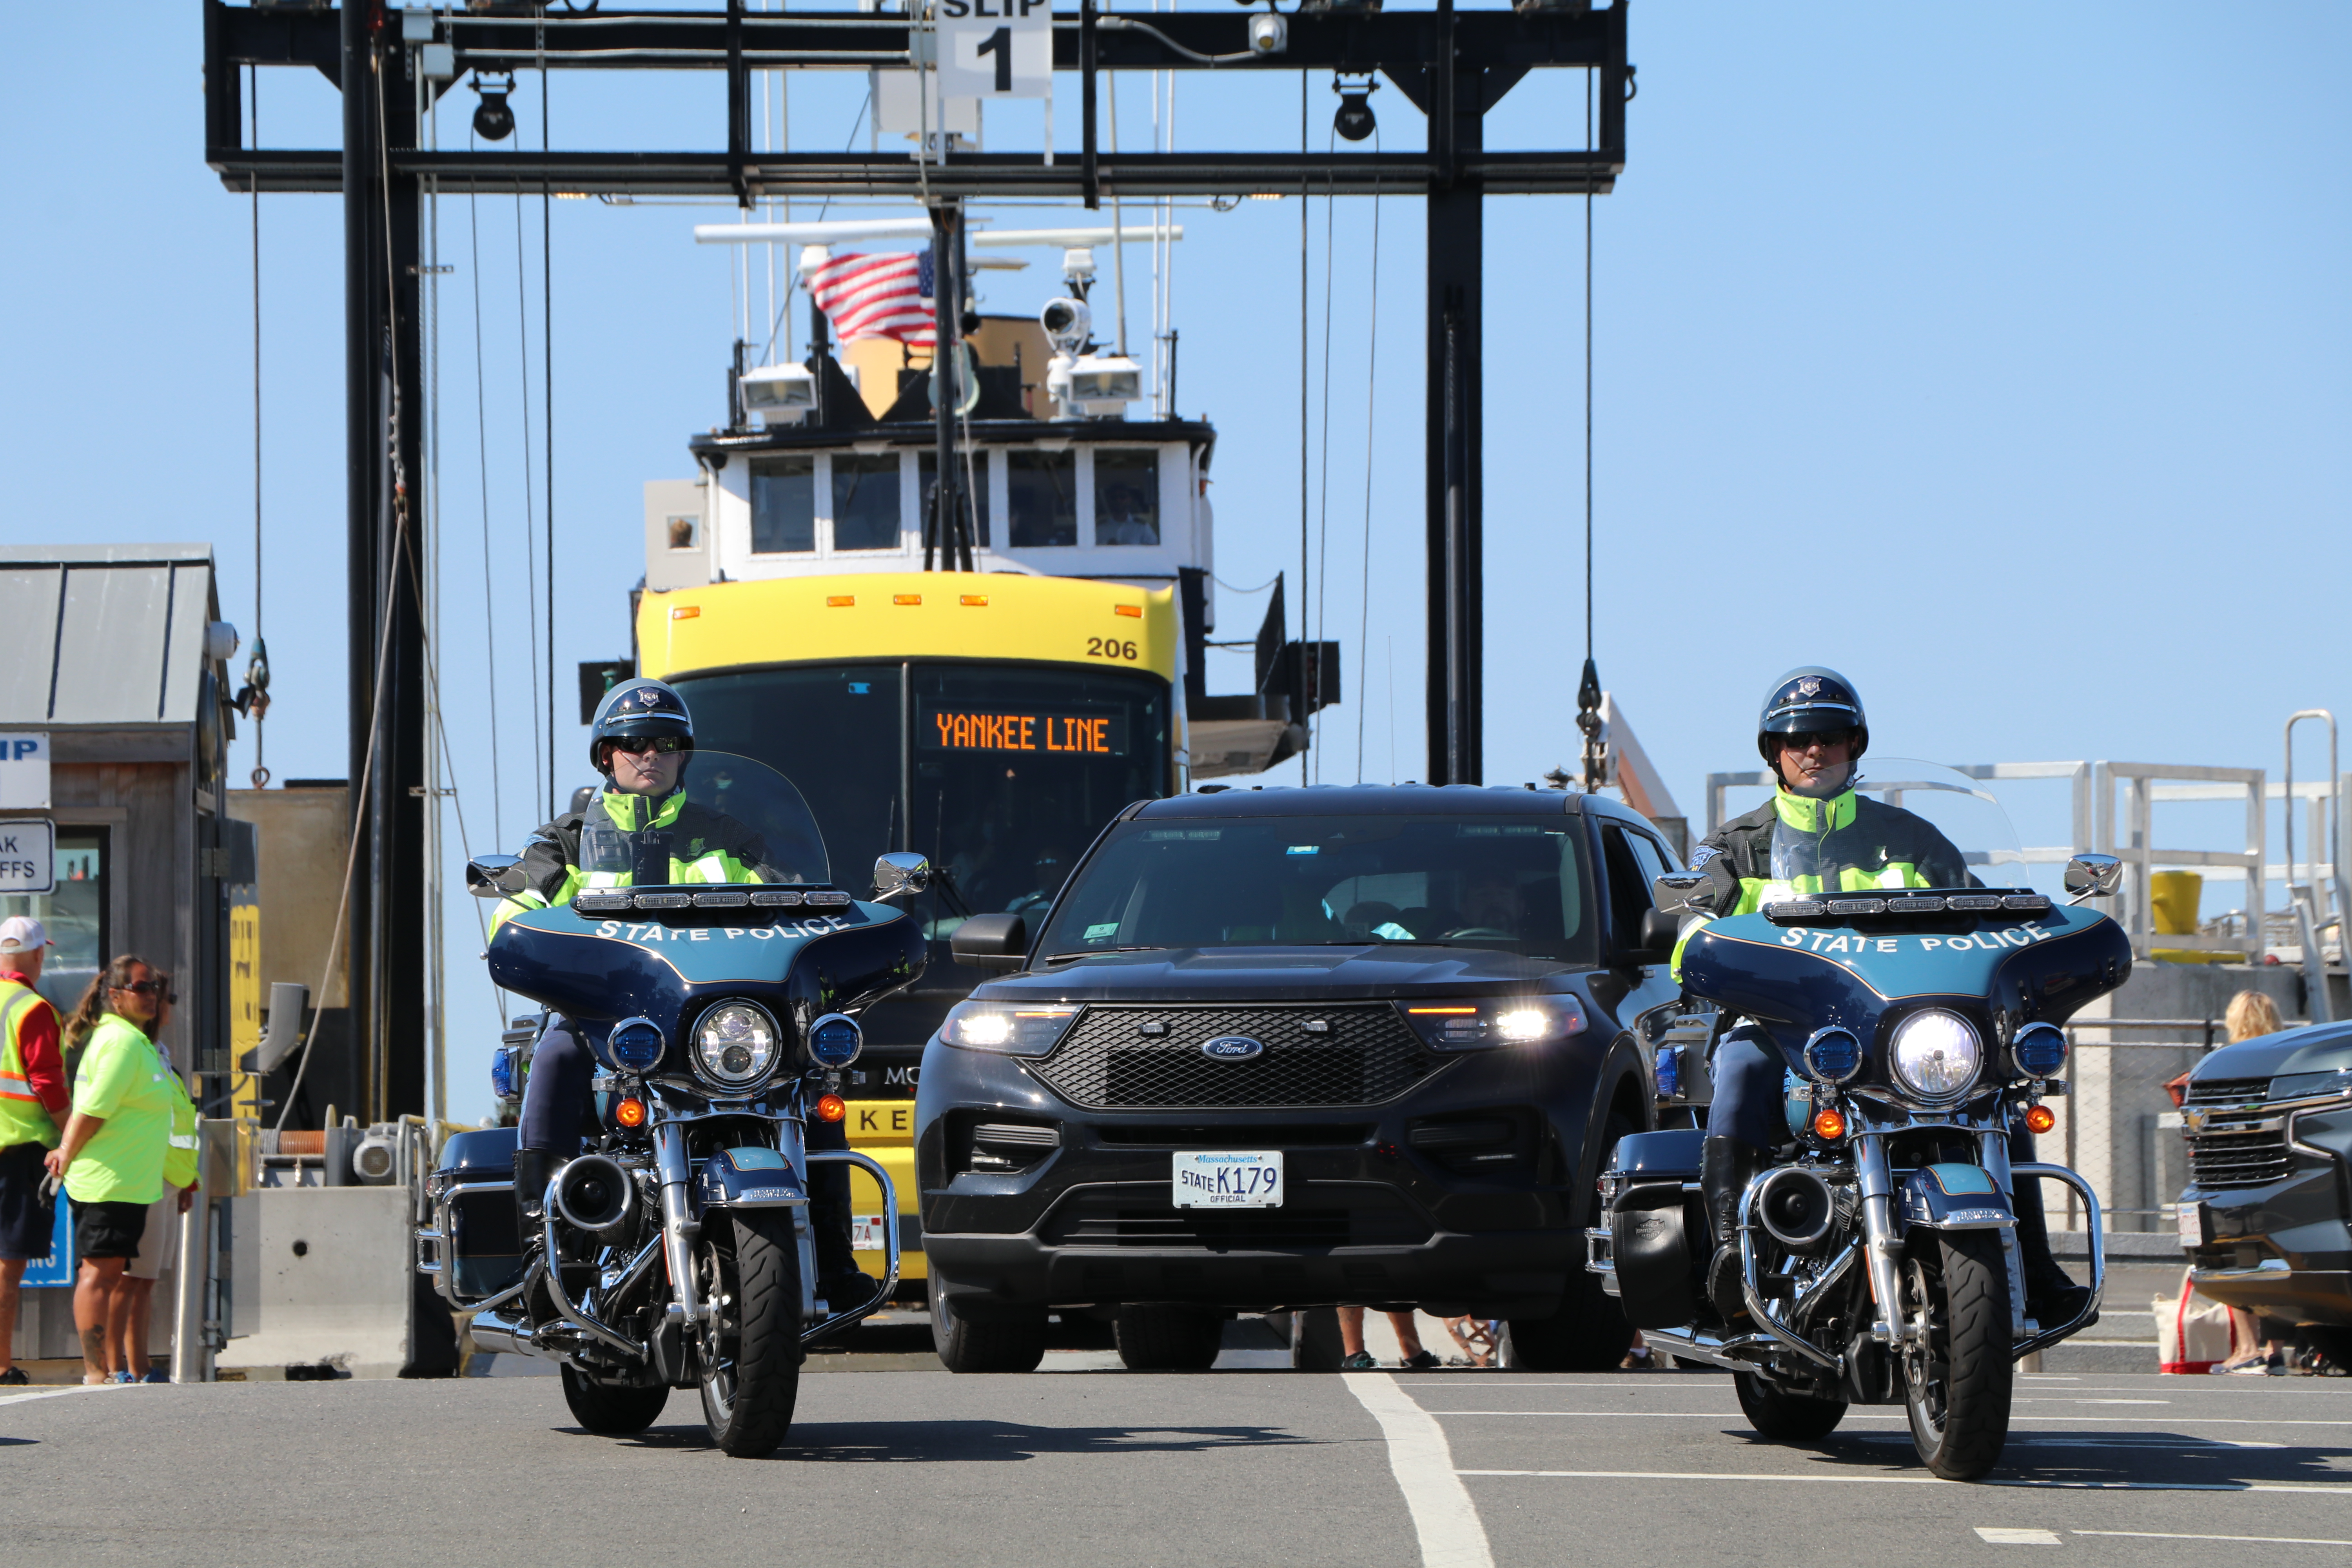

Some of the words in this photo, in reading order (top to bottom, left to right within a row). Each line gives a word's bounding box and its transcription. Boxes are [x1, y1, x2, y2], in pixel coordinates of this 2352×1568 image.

[943, 0, 1044, 17] SLIP
[978, 26, 1011, 91] 1
[1087, 637, 1137, 660] 206
[937, 713, 1035, 750] YANKEE
[1047, 717, 1109, 752] LINE
[595, 920, 710, 941] STATE
[723, 915, 850, 940] POLICE
[1780, 927, 1898, 952] STATE
[1919, 920, 2052, 950] POLICE
[1216, 1041, 1247, 1054] Ford
[843, 1110, 907, 1131] KE
[1198, 1155, 1258, 1163] Massachusetts
[1182, 1170, 1214, 1192] STATE
[1217, 1167, 1276, 1194] K179
[1905, 1188, 1911, 1202] 24
